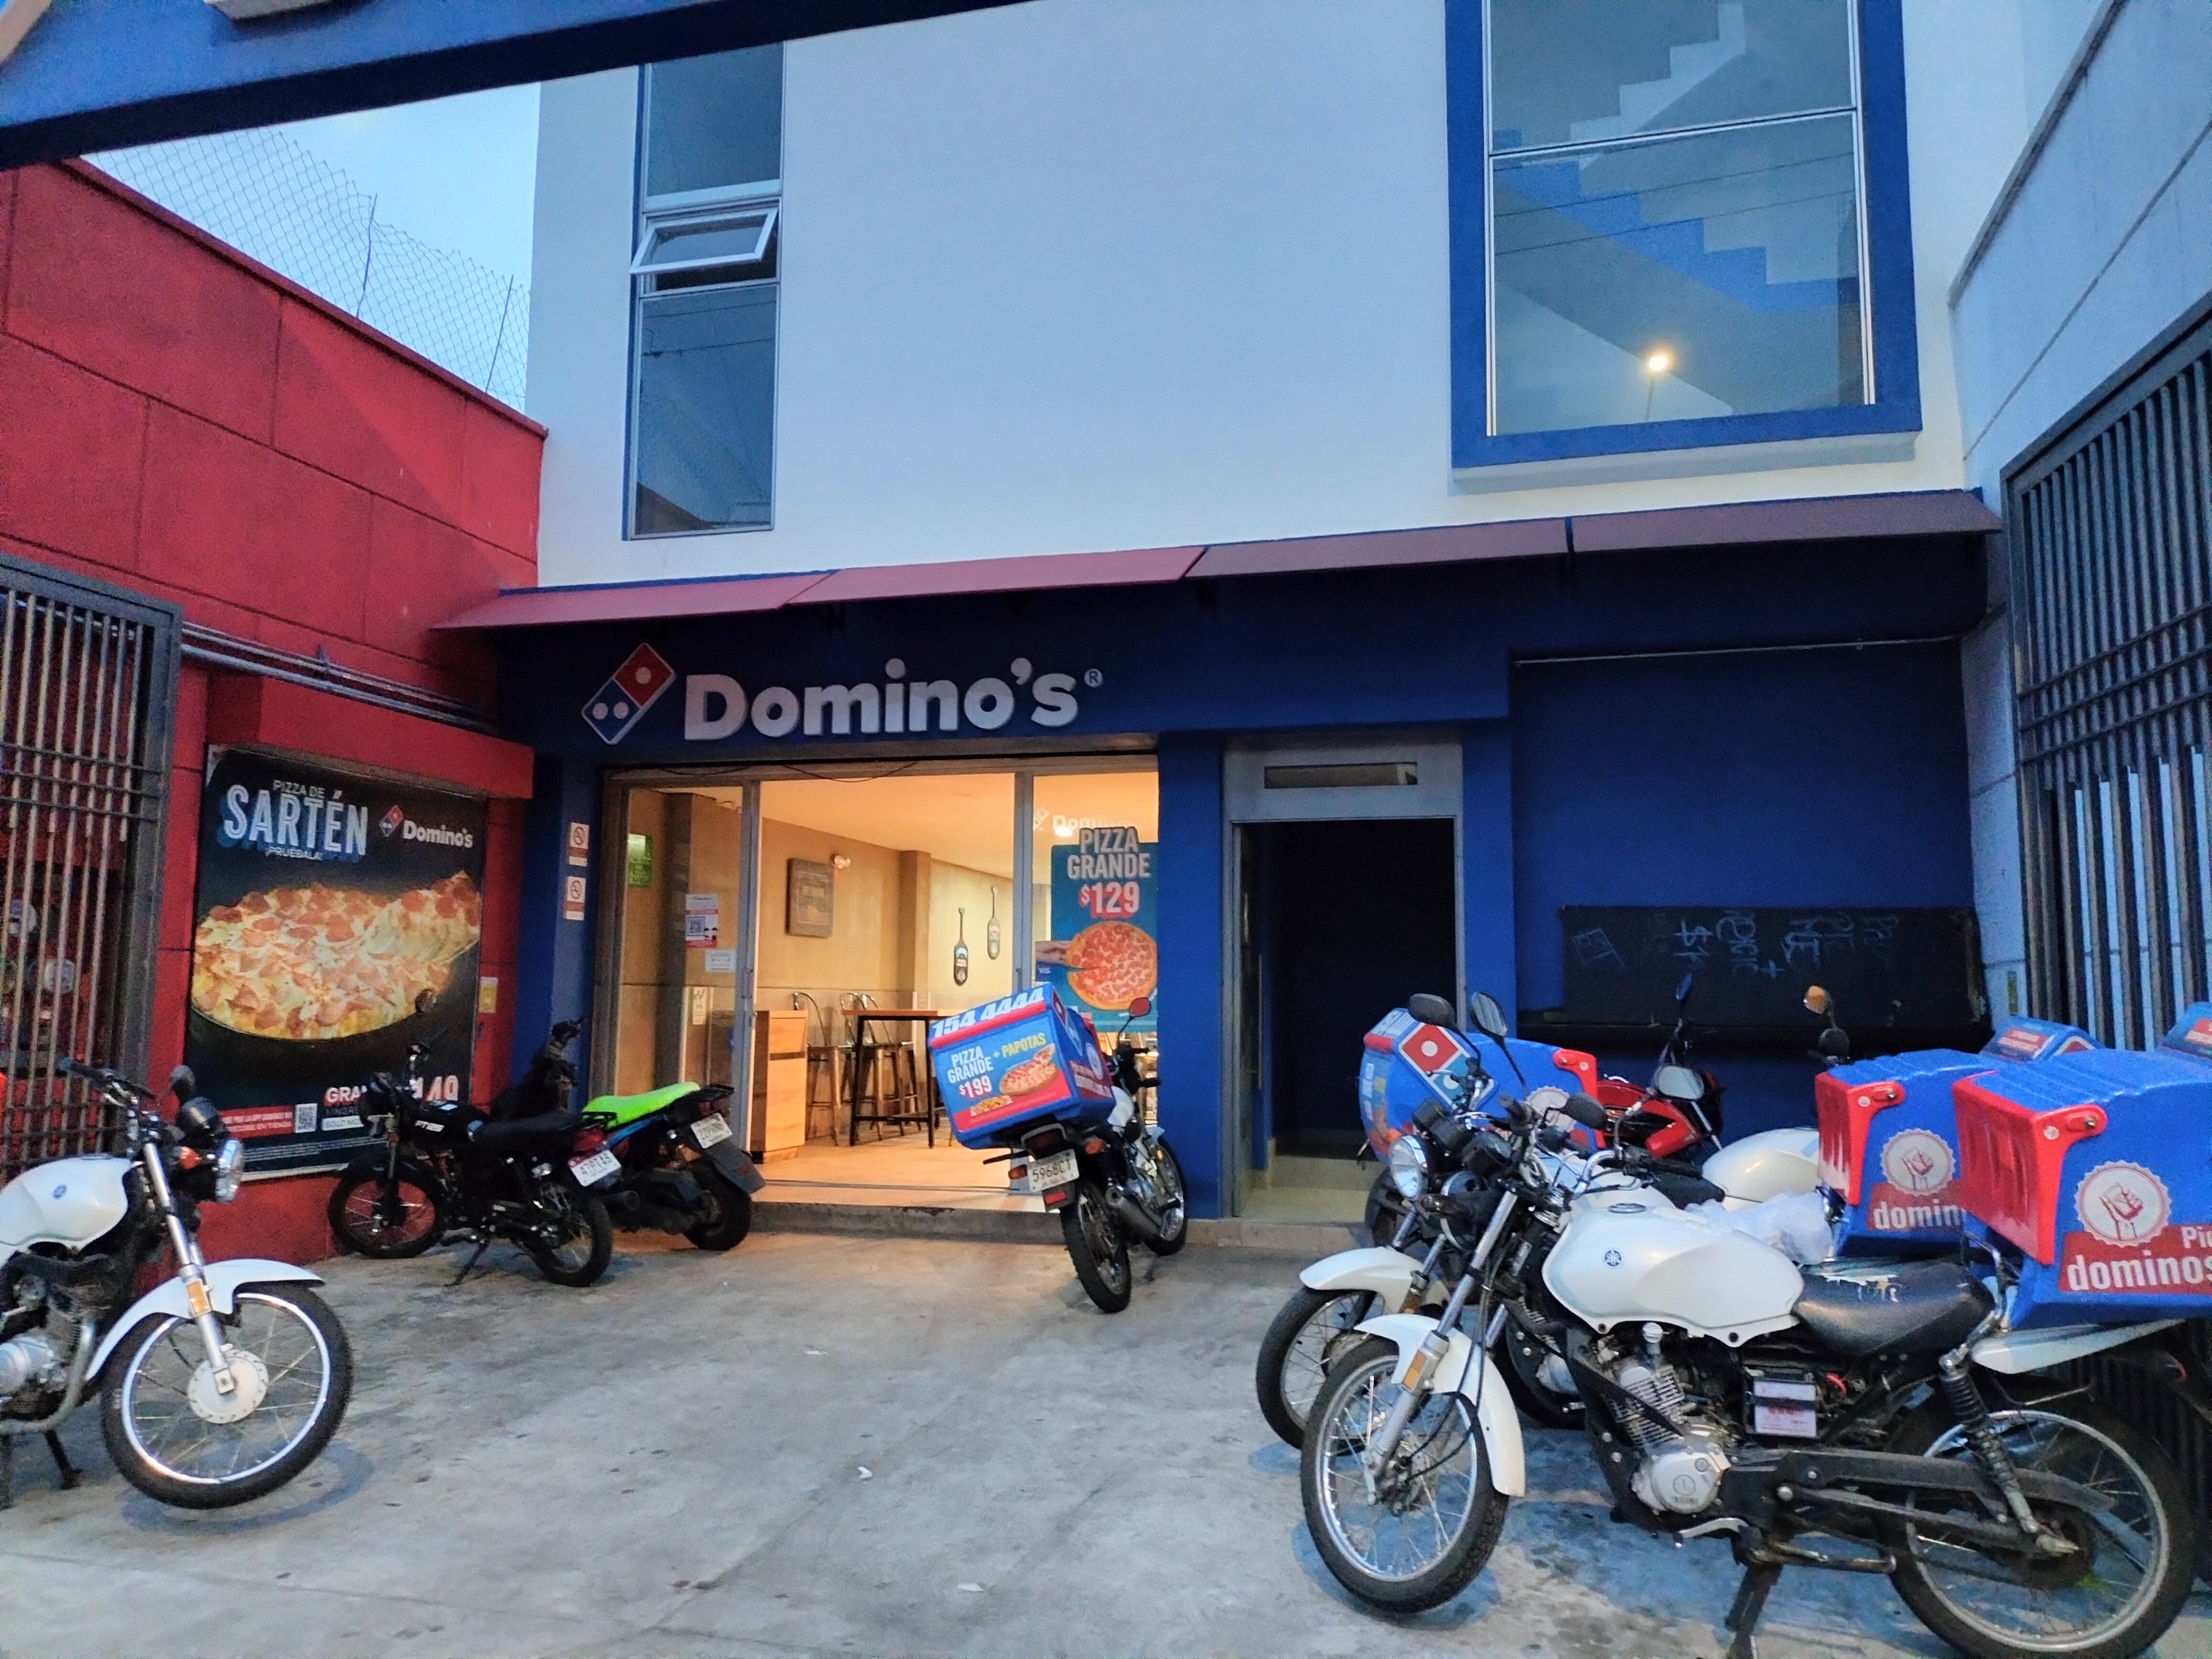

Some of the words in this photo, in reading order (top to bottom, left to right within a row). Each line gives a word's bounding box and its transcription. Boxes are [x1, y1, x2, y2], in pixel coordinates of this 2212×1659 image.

[684, 658, 1079, 741] Domino's
[273, 779, 307, 796] PIZZA
[309, 785, 326, 799] DE
[223, 784, 368, 856] SARTÉN
[403, 819, 474, 849] Domino's
[1080, 828, 1139, 853] PIZZA
[1067, 853, 1151, 879] GRANDE
[1080, 881, 1139, 913] $129
[933, 1009, 976, 1039] 154
[980, 987, 1044, 1021] 4444
[951, 1046, 984, 1068] PIZZA
[1001, 1032, 1046, 1058] PAPOTAS
[947, 1056, 994, 1084] GRANDE
[959, 1075, 992, 1098] $199
[1873, 1199, 1967, 1229] domin
